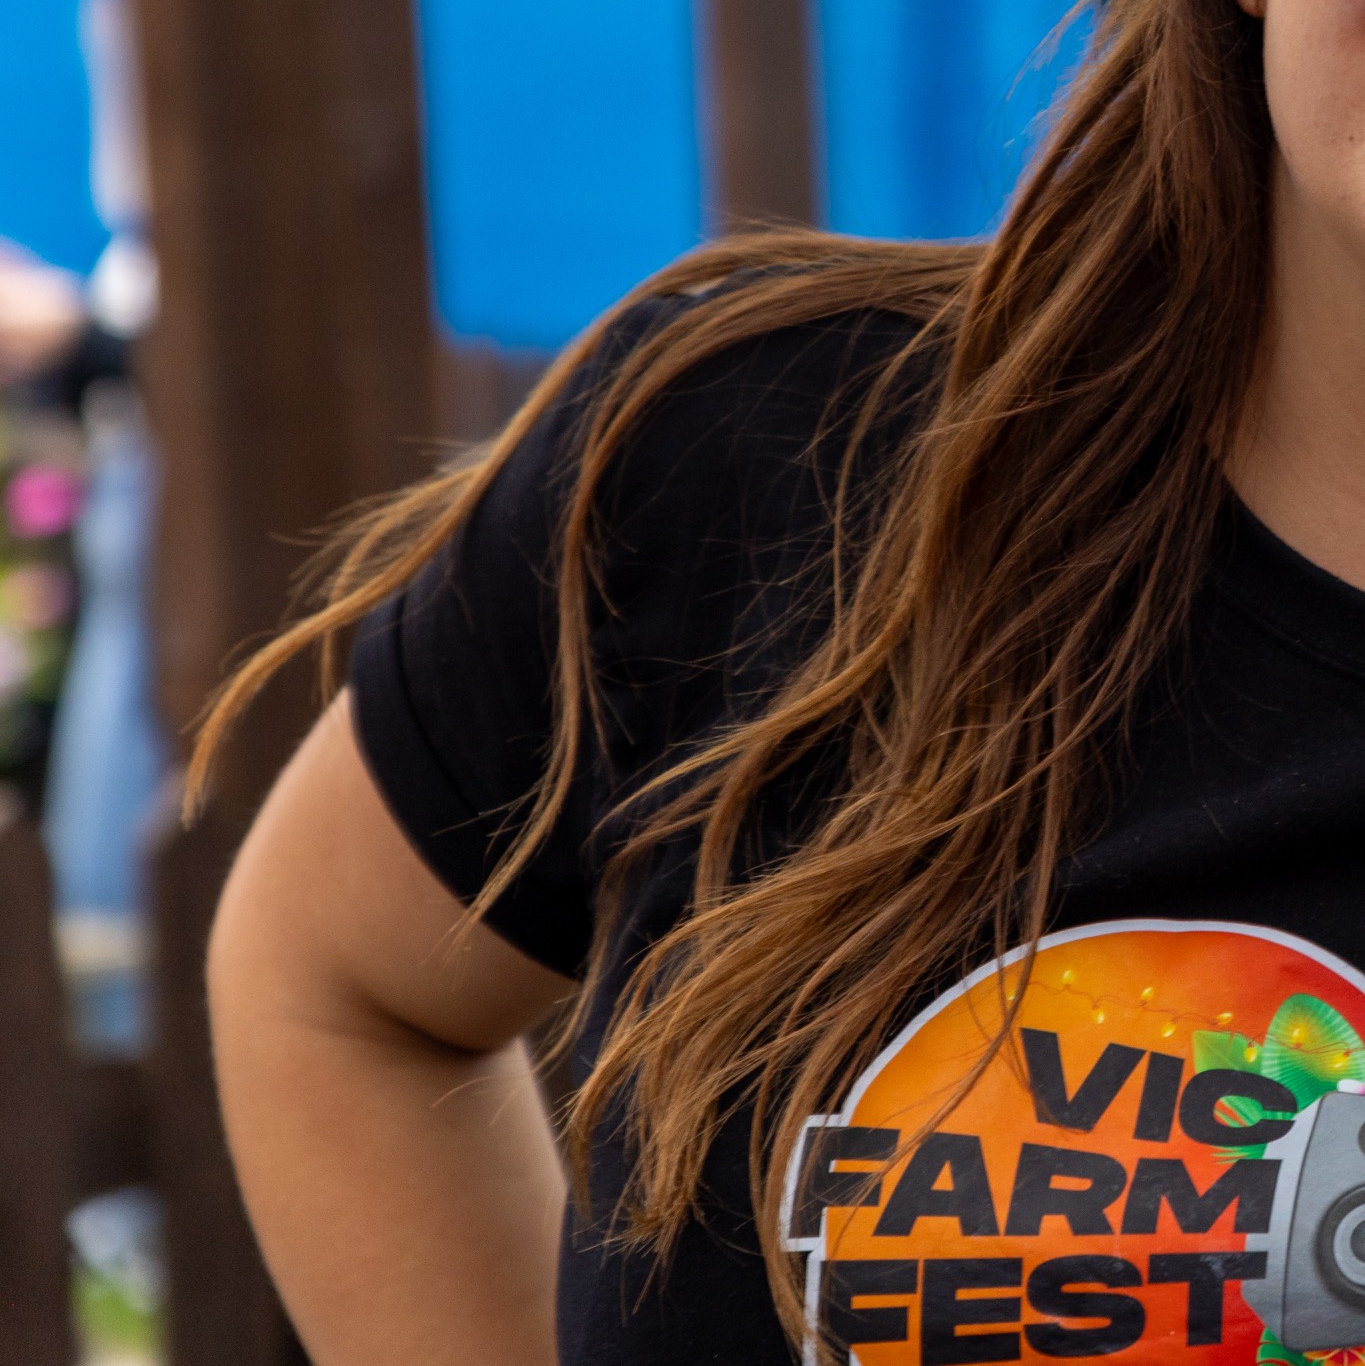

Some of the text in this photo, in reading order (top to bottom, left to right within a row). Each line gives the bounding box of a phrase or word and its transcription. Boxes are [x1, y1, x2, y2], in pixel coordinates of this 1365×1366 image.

[1020, 1027, 1298, 1146] VIC
[788, 1126, 1283, 1237] FARM
[814, 1251, 1266, 1366] FEST
